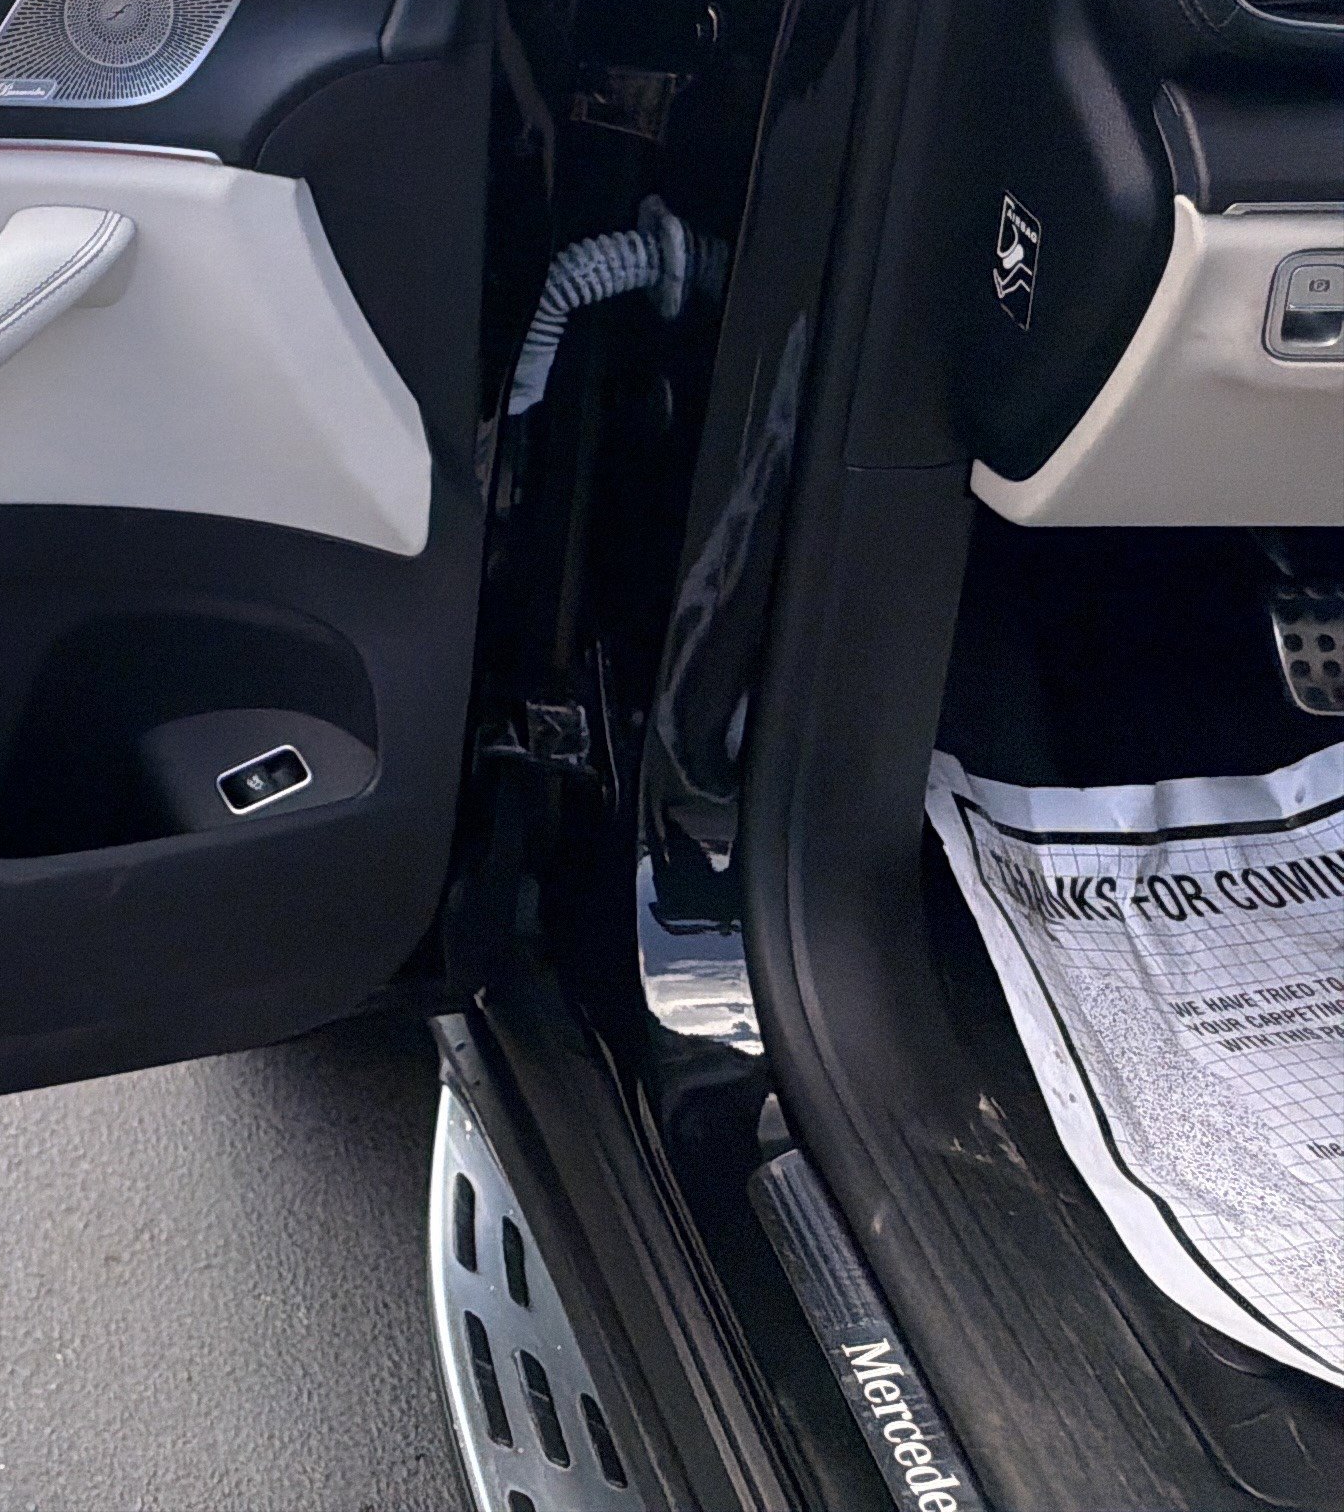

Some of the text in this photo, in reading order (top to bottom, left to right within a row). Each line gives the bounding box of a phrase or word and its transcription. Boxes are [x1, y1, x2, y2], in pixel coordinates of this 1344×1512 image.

[989, 850, 1126, 924] THANKS
[1130, 873, 1225, 923] FOR
[1168, 976, 1344, 1019] WE HAVE TRIED TO
[1185, 1017, 1244, 1037] YOUR
[1216, 1034, 1277, 1054] WITH
[1273, 1026, 1318, 1047] THIS
[1306, 1140, 1342, 1160] the
[840, 1337, 961, 1512] Mercede
